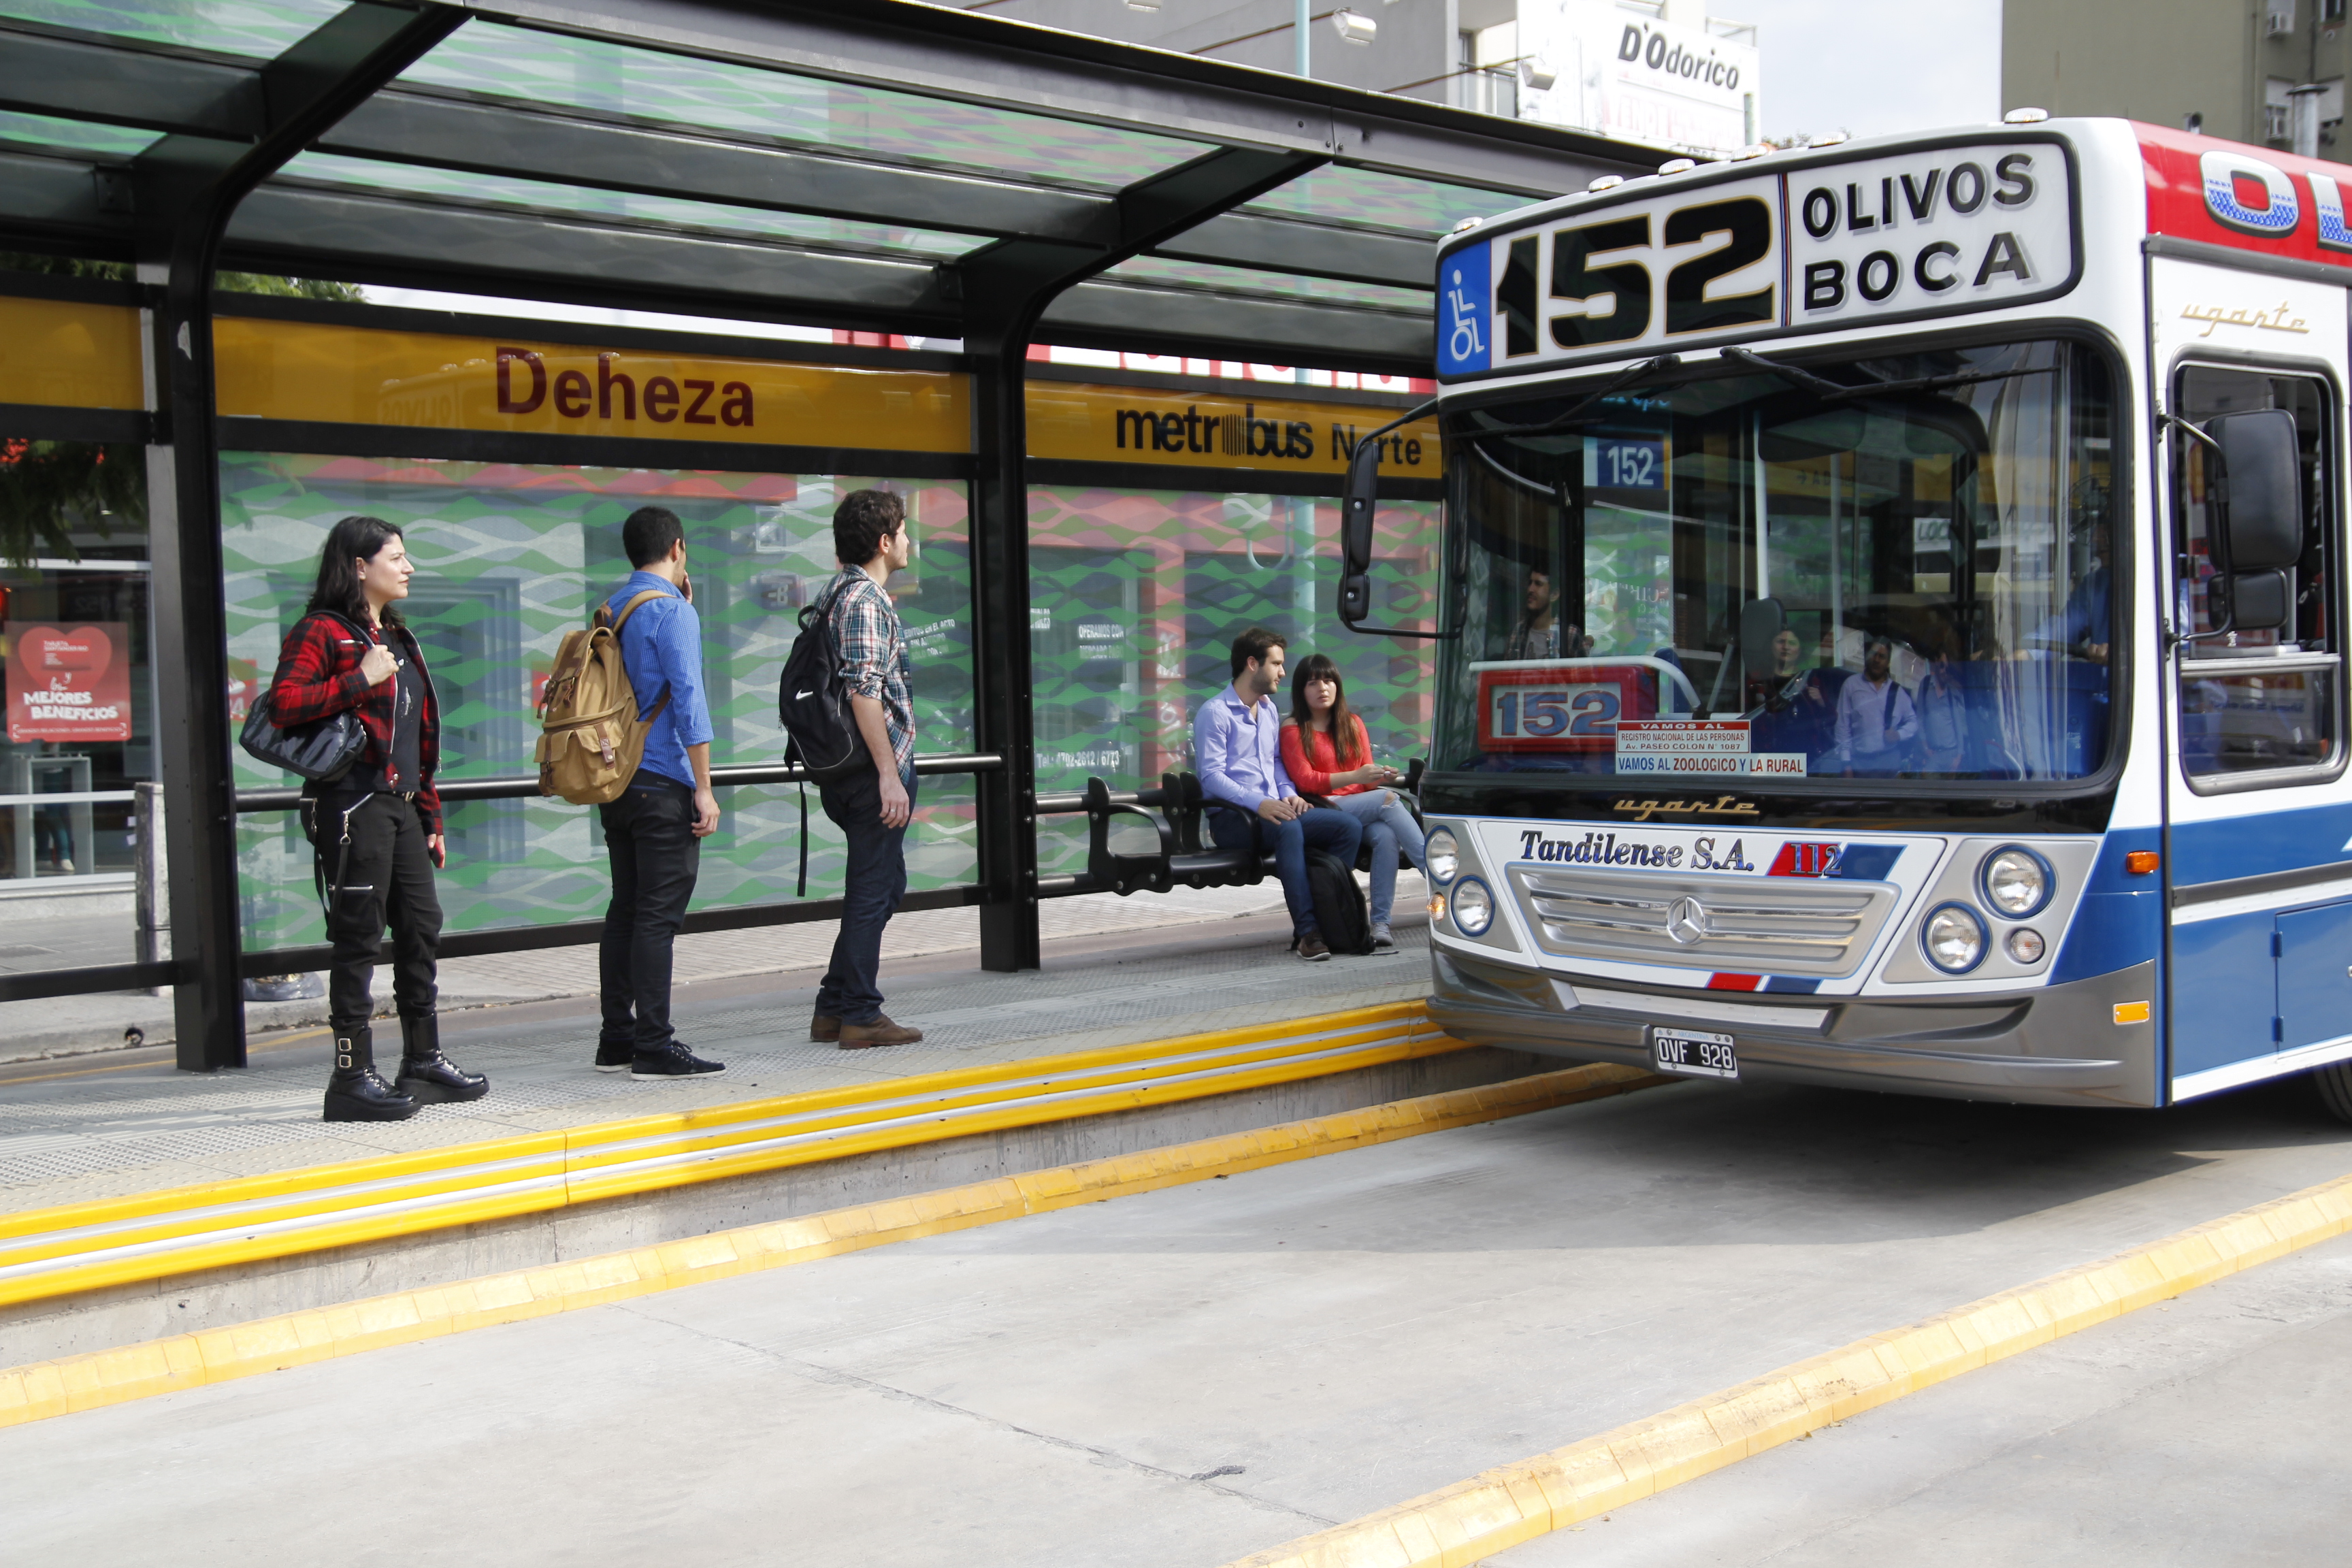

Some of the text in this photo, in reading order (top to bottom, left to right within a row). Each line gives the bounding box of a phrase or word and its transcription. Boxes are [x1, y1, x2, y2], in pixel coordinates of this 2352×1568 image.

[1618, 22, 1740, 91] D'Odorico
[1803, 152, 2037, 240] OLIVOS
[1496, 194, 1776, 359] 152
[1804, 231, 2036, 312] BOCA
[2180, 300, 2310, 338] ugarte
[495, 345, 755, 427] Deheza
[1332, 423, 1422, 466] Nrte
[1607, 446, 1654, 485] 152
[23, 691, 93, 705] MEJORES
[31, 705, 119, 721] BENEFICIOS
[1497, 689, 1620, 737] 152
[1621, 733, 1745, 741] REGISTRO NACIONAL DE LAS PERSONAS
[1618, 757, 1803, 772] VAMOS AL ZOOLOGICO Y LA RURAL
[1613, 795, 1761, 821] ugarte
[1520, 830, 1842, 877] Tandilense S.A. 112
[1658, 1038, 1733, 1069] OVF 928
[1678, 1030, 1710, 1040] ARGENTINA
